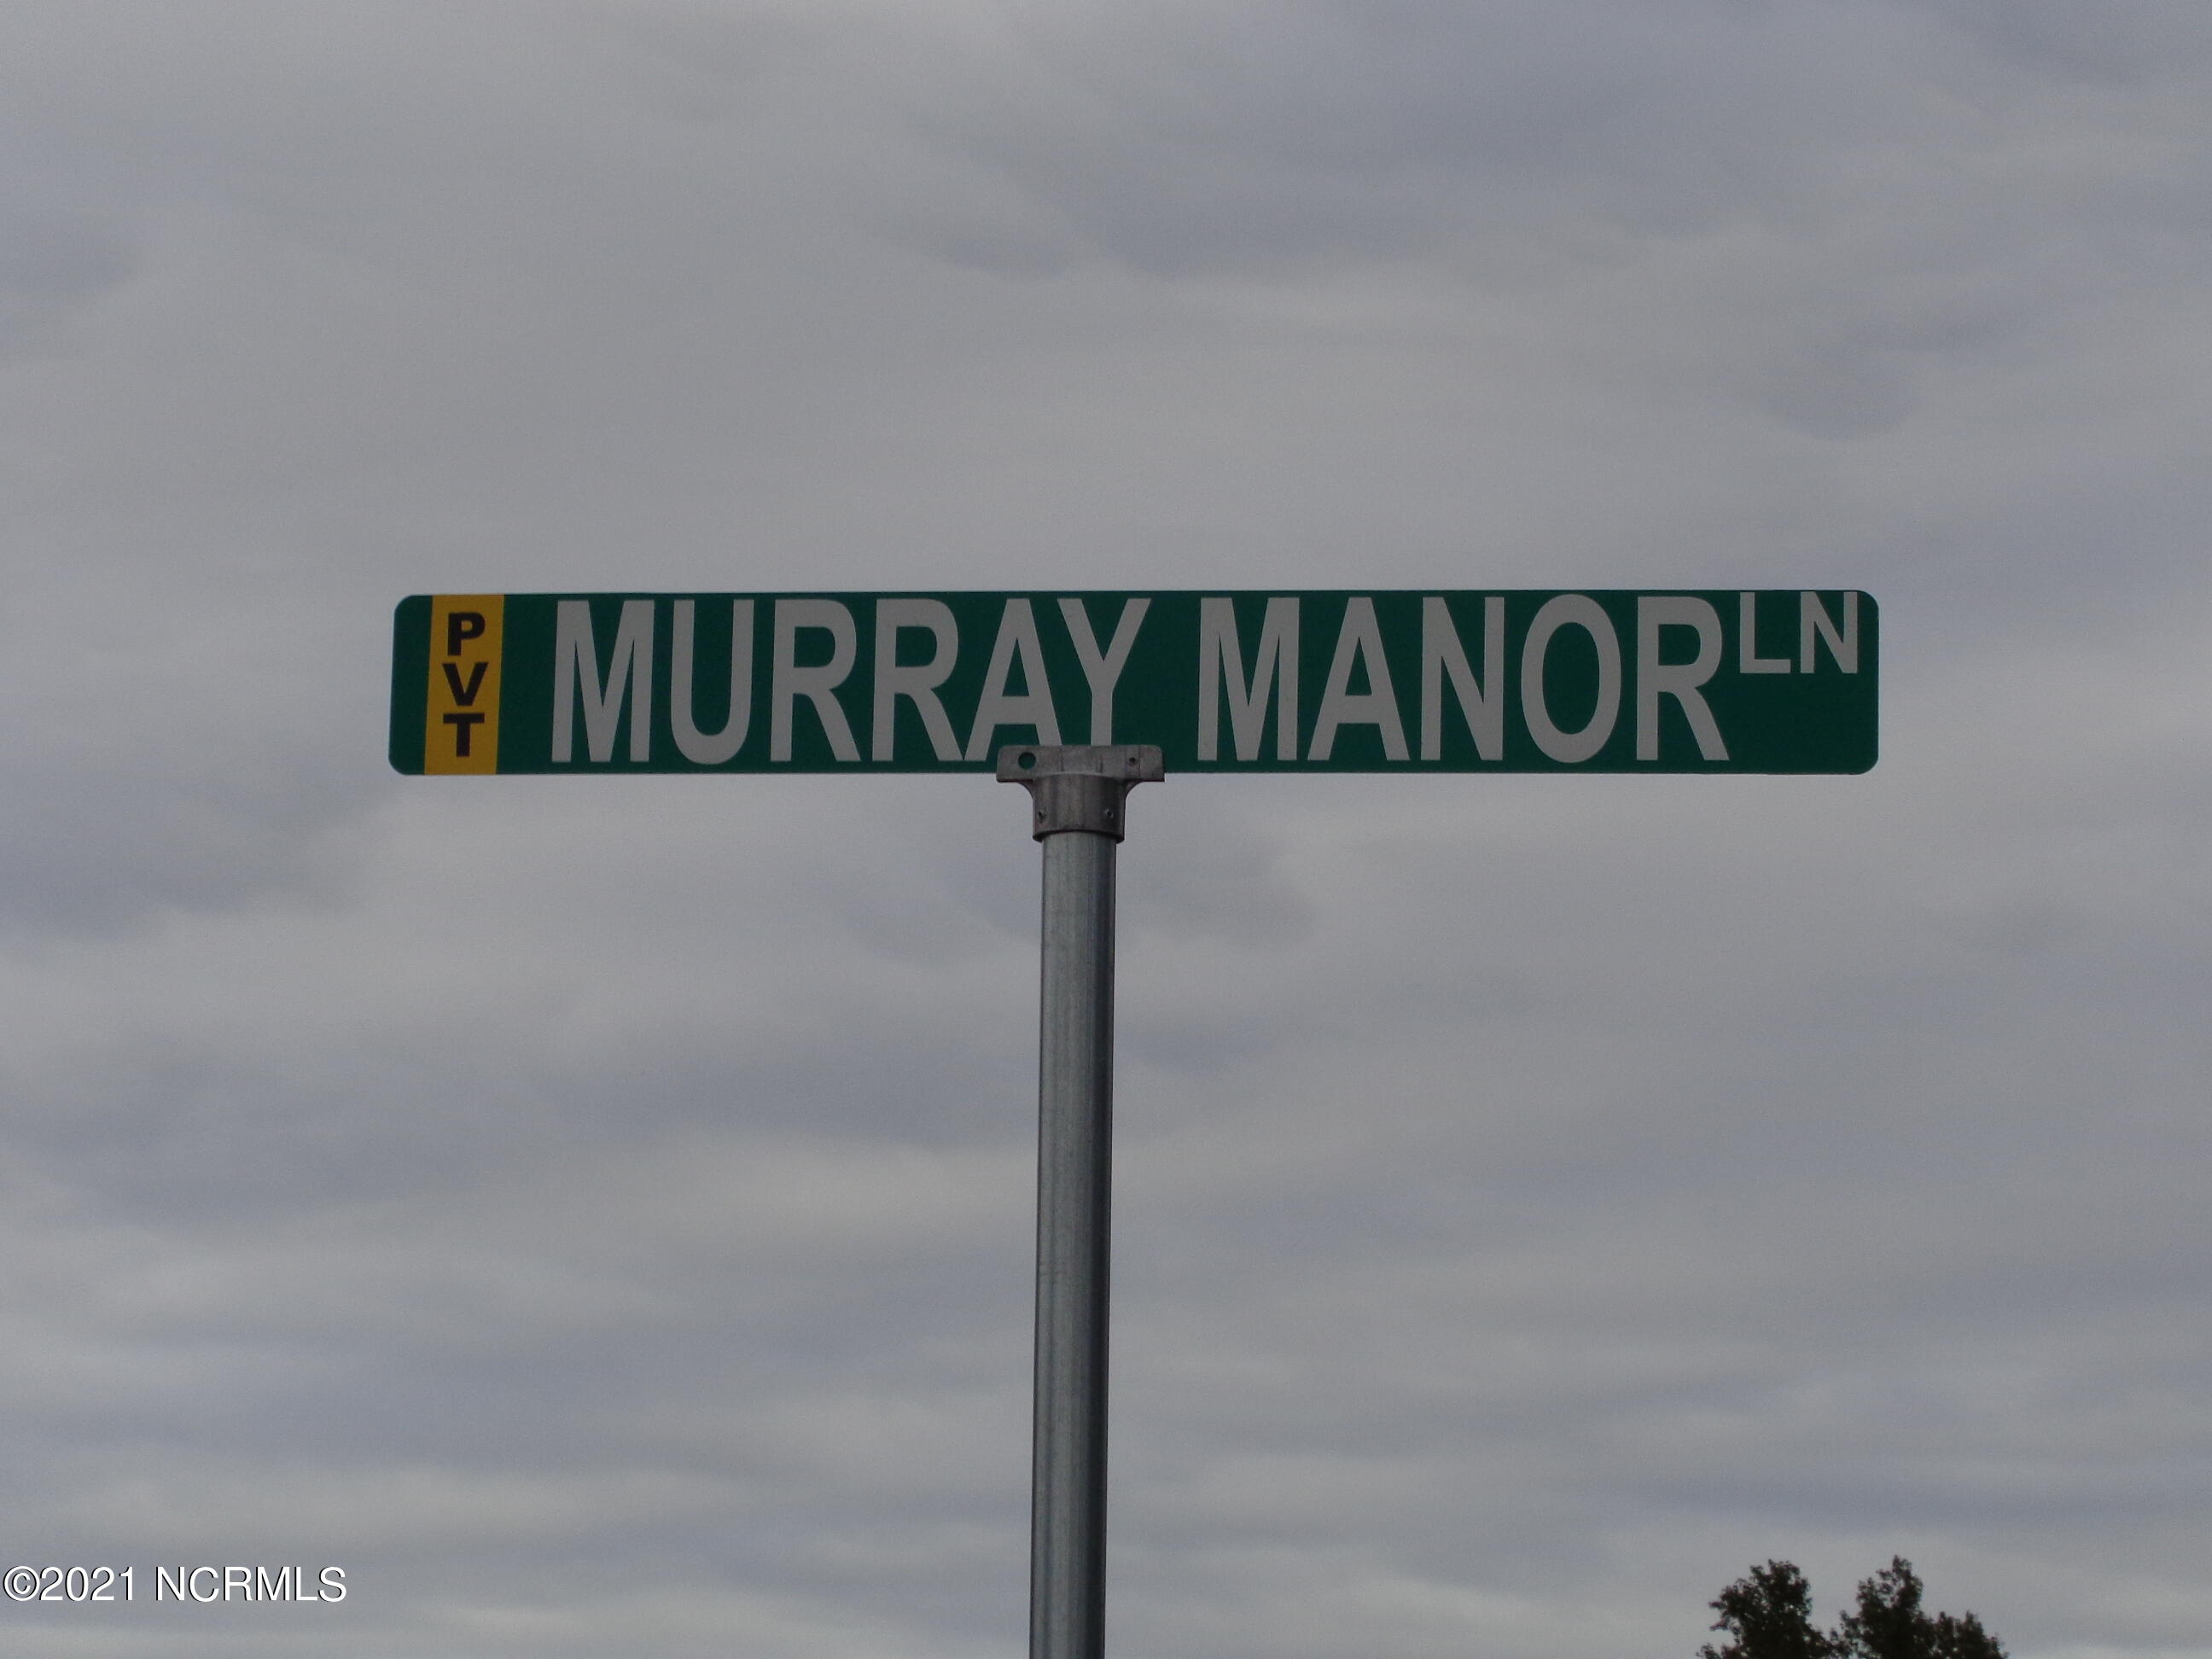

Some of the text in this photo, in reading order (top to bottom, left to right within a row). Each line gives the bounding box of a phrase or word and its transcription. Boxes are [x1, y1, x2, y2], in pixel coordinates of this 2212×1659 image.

[440, 610, 489, 759] PVT
[551, 591, 1858, 764] MURRAY MANOR LN
